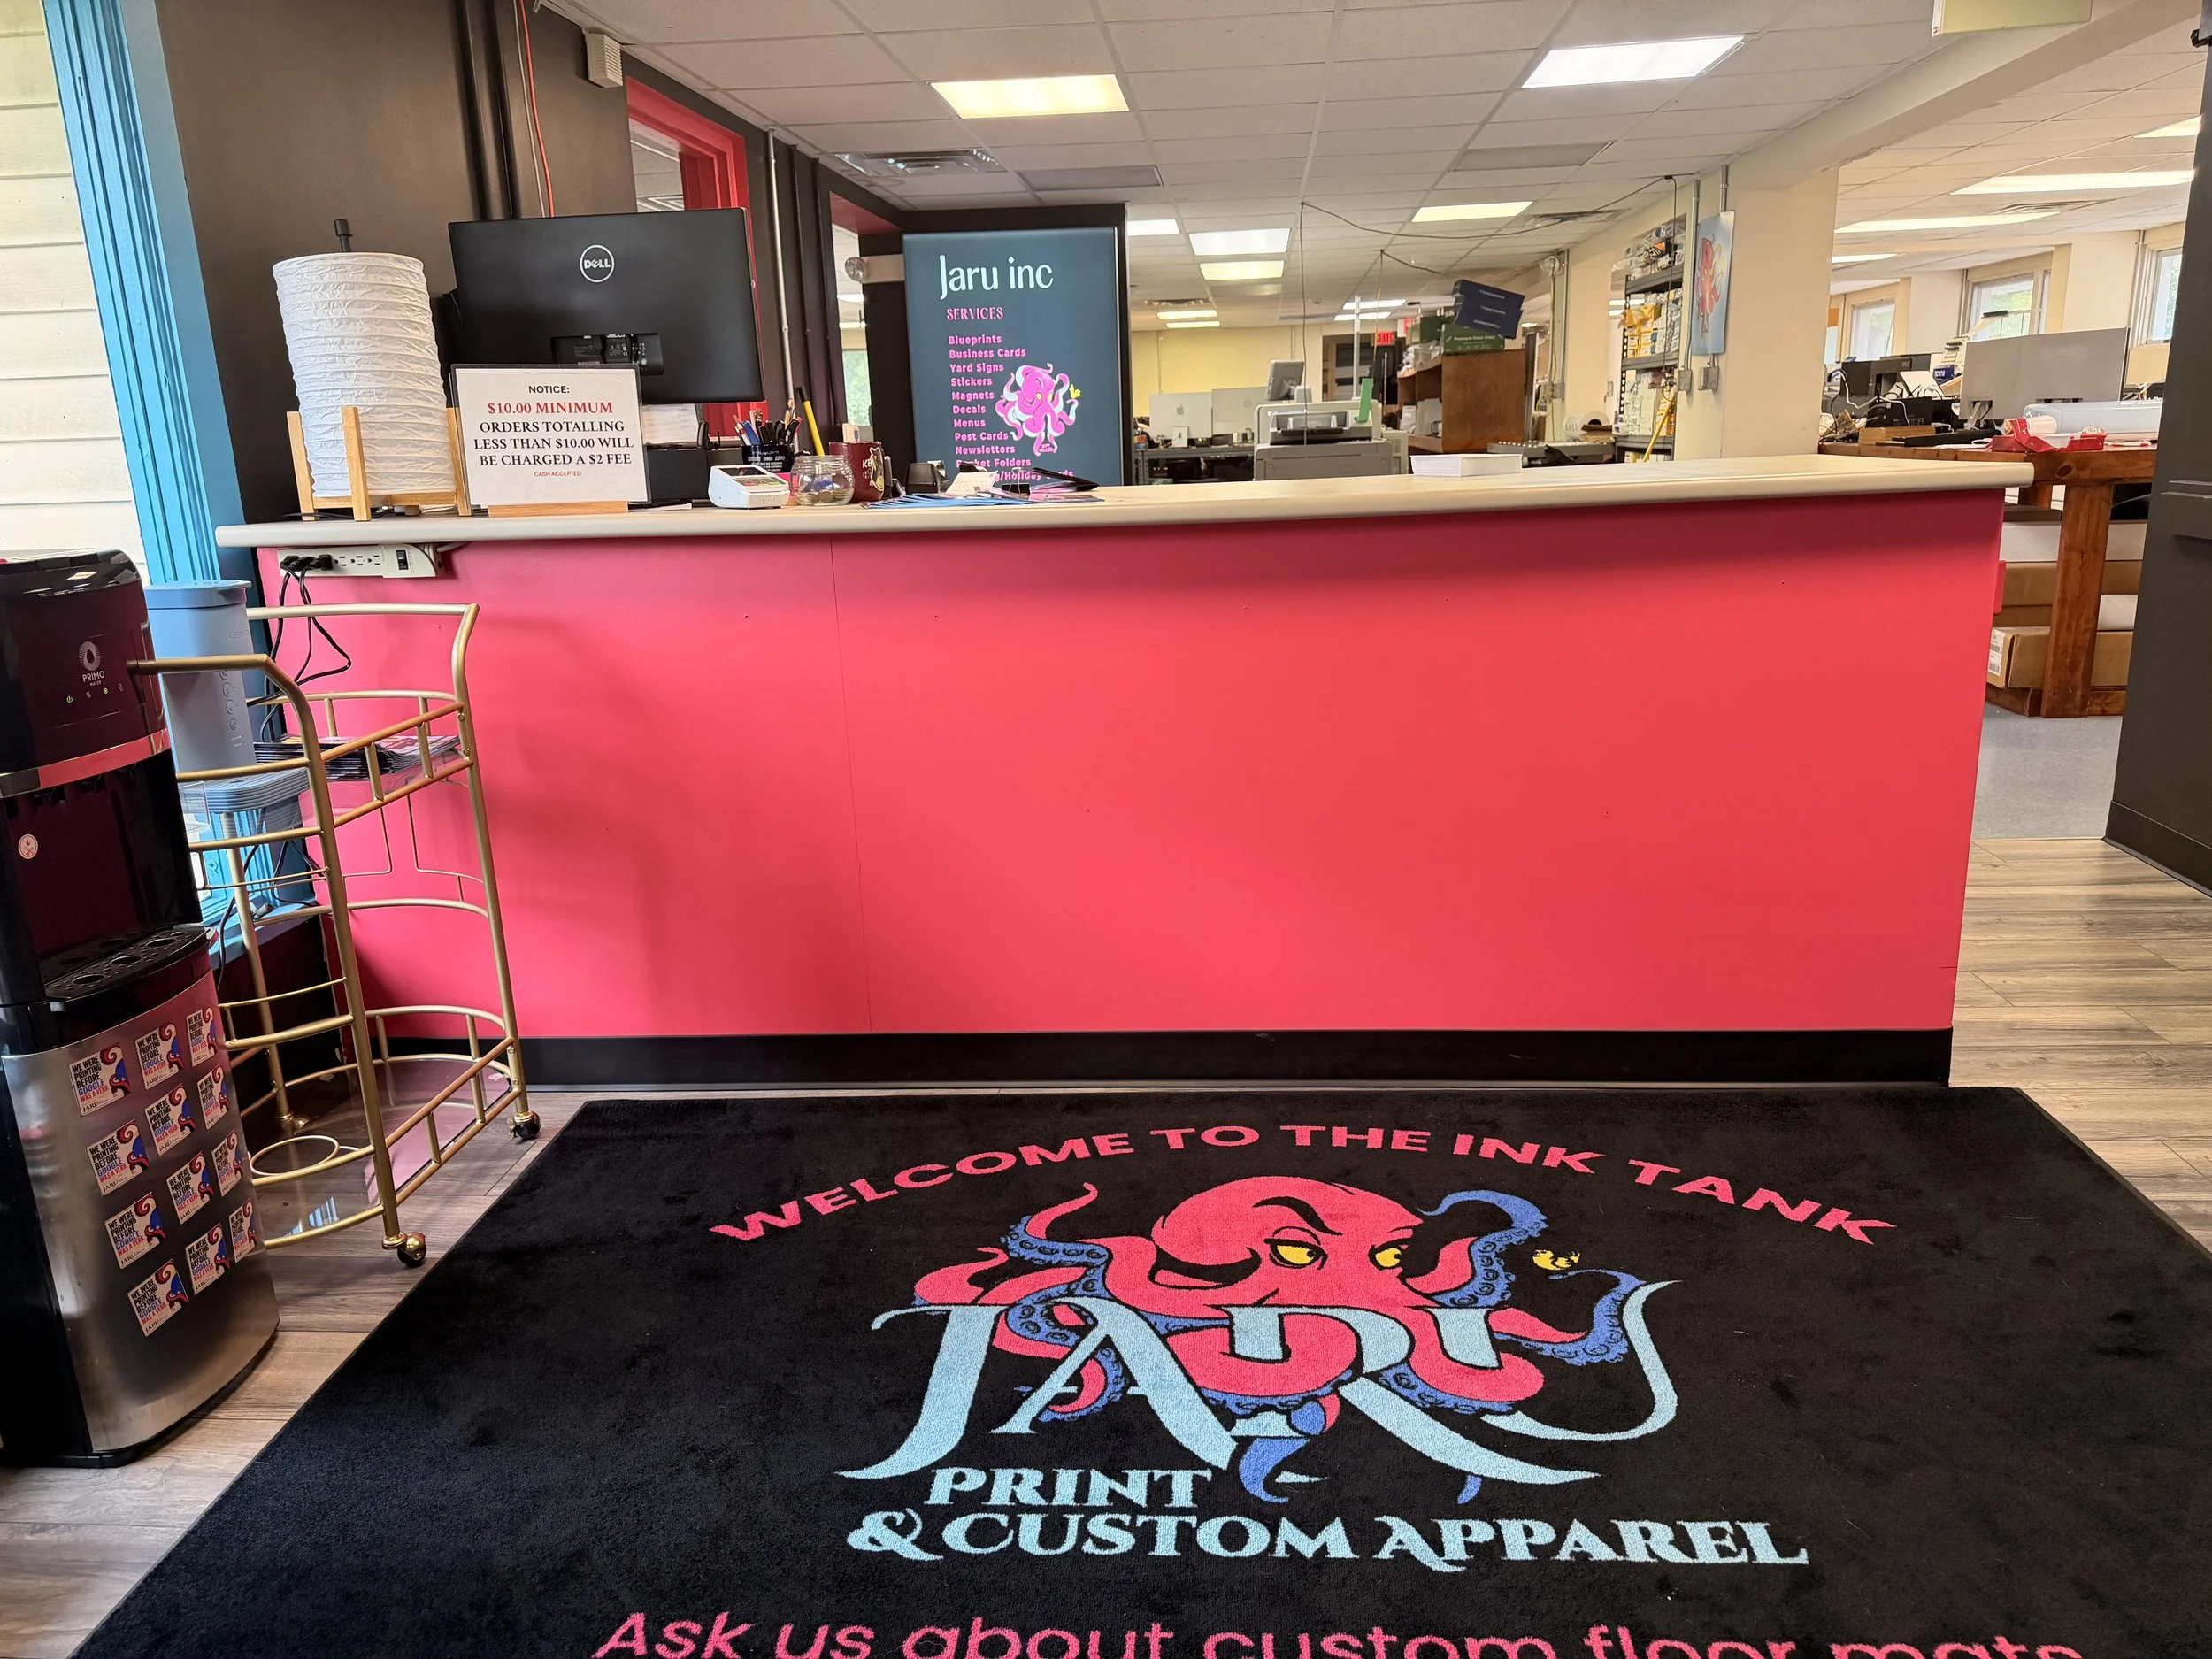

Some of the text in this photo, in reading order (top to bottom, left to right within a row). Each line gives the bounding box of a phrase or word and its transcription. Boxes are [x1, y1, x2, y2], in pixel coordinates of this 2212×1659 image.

[584, 258, 611, 269] DELL
[940, 255, 1053, 300] Jaru inc
[948, 307, 1004, 320] SERVICES
[949, 335, 1002, 346] Blueprints
[949, 349, 1026, 360] Business Cards
[949, 361, 1005, 374] Yard Signs
[950, 377, 993, 388] Stickers
[951, 391, 995, 403] Magnets
[488, 402, 612, 413] $10.00 MINIMUM
[952, 404, 987, 415] Decals
[480, 421, 624, 433] ORDERS TOTALLING
[953, 419, 987, 428] Menus
[474, 438, 634, 449] LESS THAN $10.00 WILL
[954, 432, 1010, 442] Post Cards
[955, 445, 1016, 455] Newsletters
[480, 454, 631, 465] BE CHARGED A $2 FEE
[994, 458, 1032, 468] Folders
[82, 671, 104, 681] PRIMO
[72, 1055, 99, 1072] WE WERE
[76, 1072, 100, 1088] BEFORE
[89, 1134, 117, 1156] WE WERE
[95, 1152, 119, 1171] BEFORE
[710, 1125, 1897, 1244] WELCOME TO THE INK TANK
[108, 1208, 134, 1229] WE WERE
[112, 1224, 136, 1243] BEFORE
[131, 1277, 156, 1300] WE WERE
[136, 1293, 158, 1313] BEFORE
[834, 1279, 1681, 1486] JARU
[923, 1467, 1212, 1508] PRINT
[941, 1513, 1361, 1560] CUSTOM
[1373, 1515, 1810, 1573] APPAREL
[595, 1613, 749, 1659] Ask
[776, 1625, 874, 1659] us
[903, 1617, 1173, 1659] about
[1204, 1628, 1556, 1659] custom
